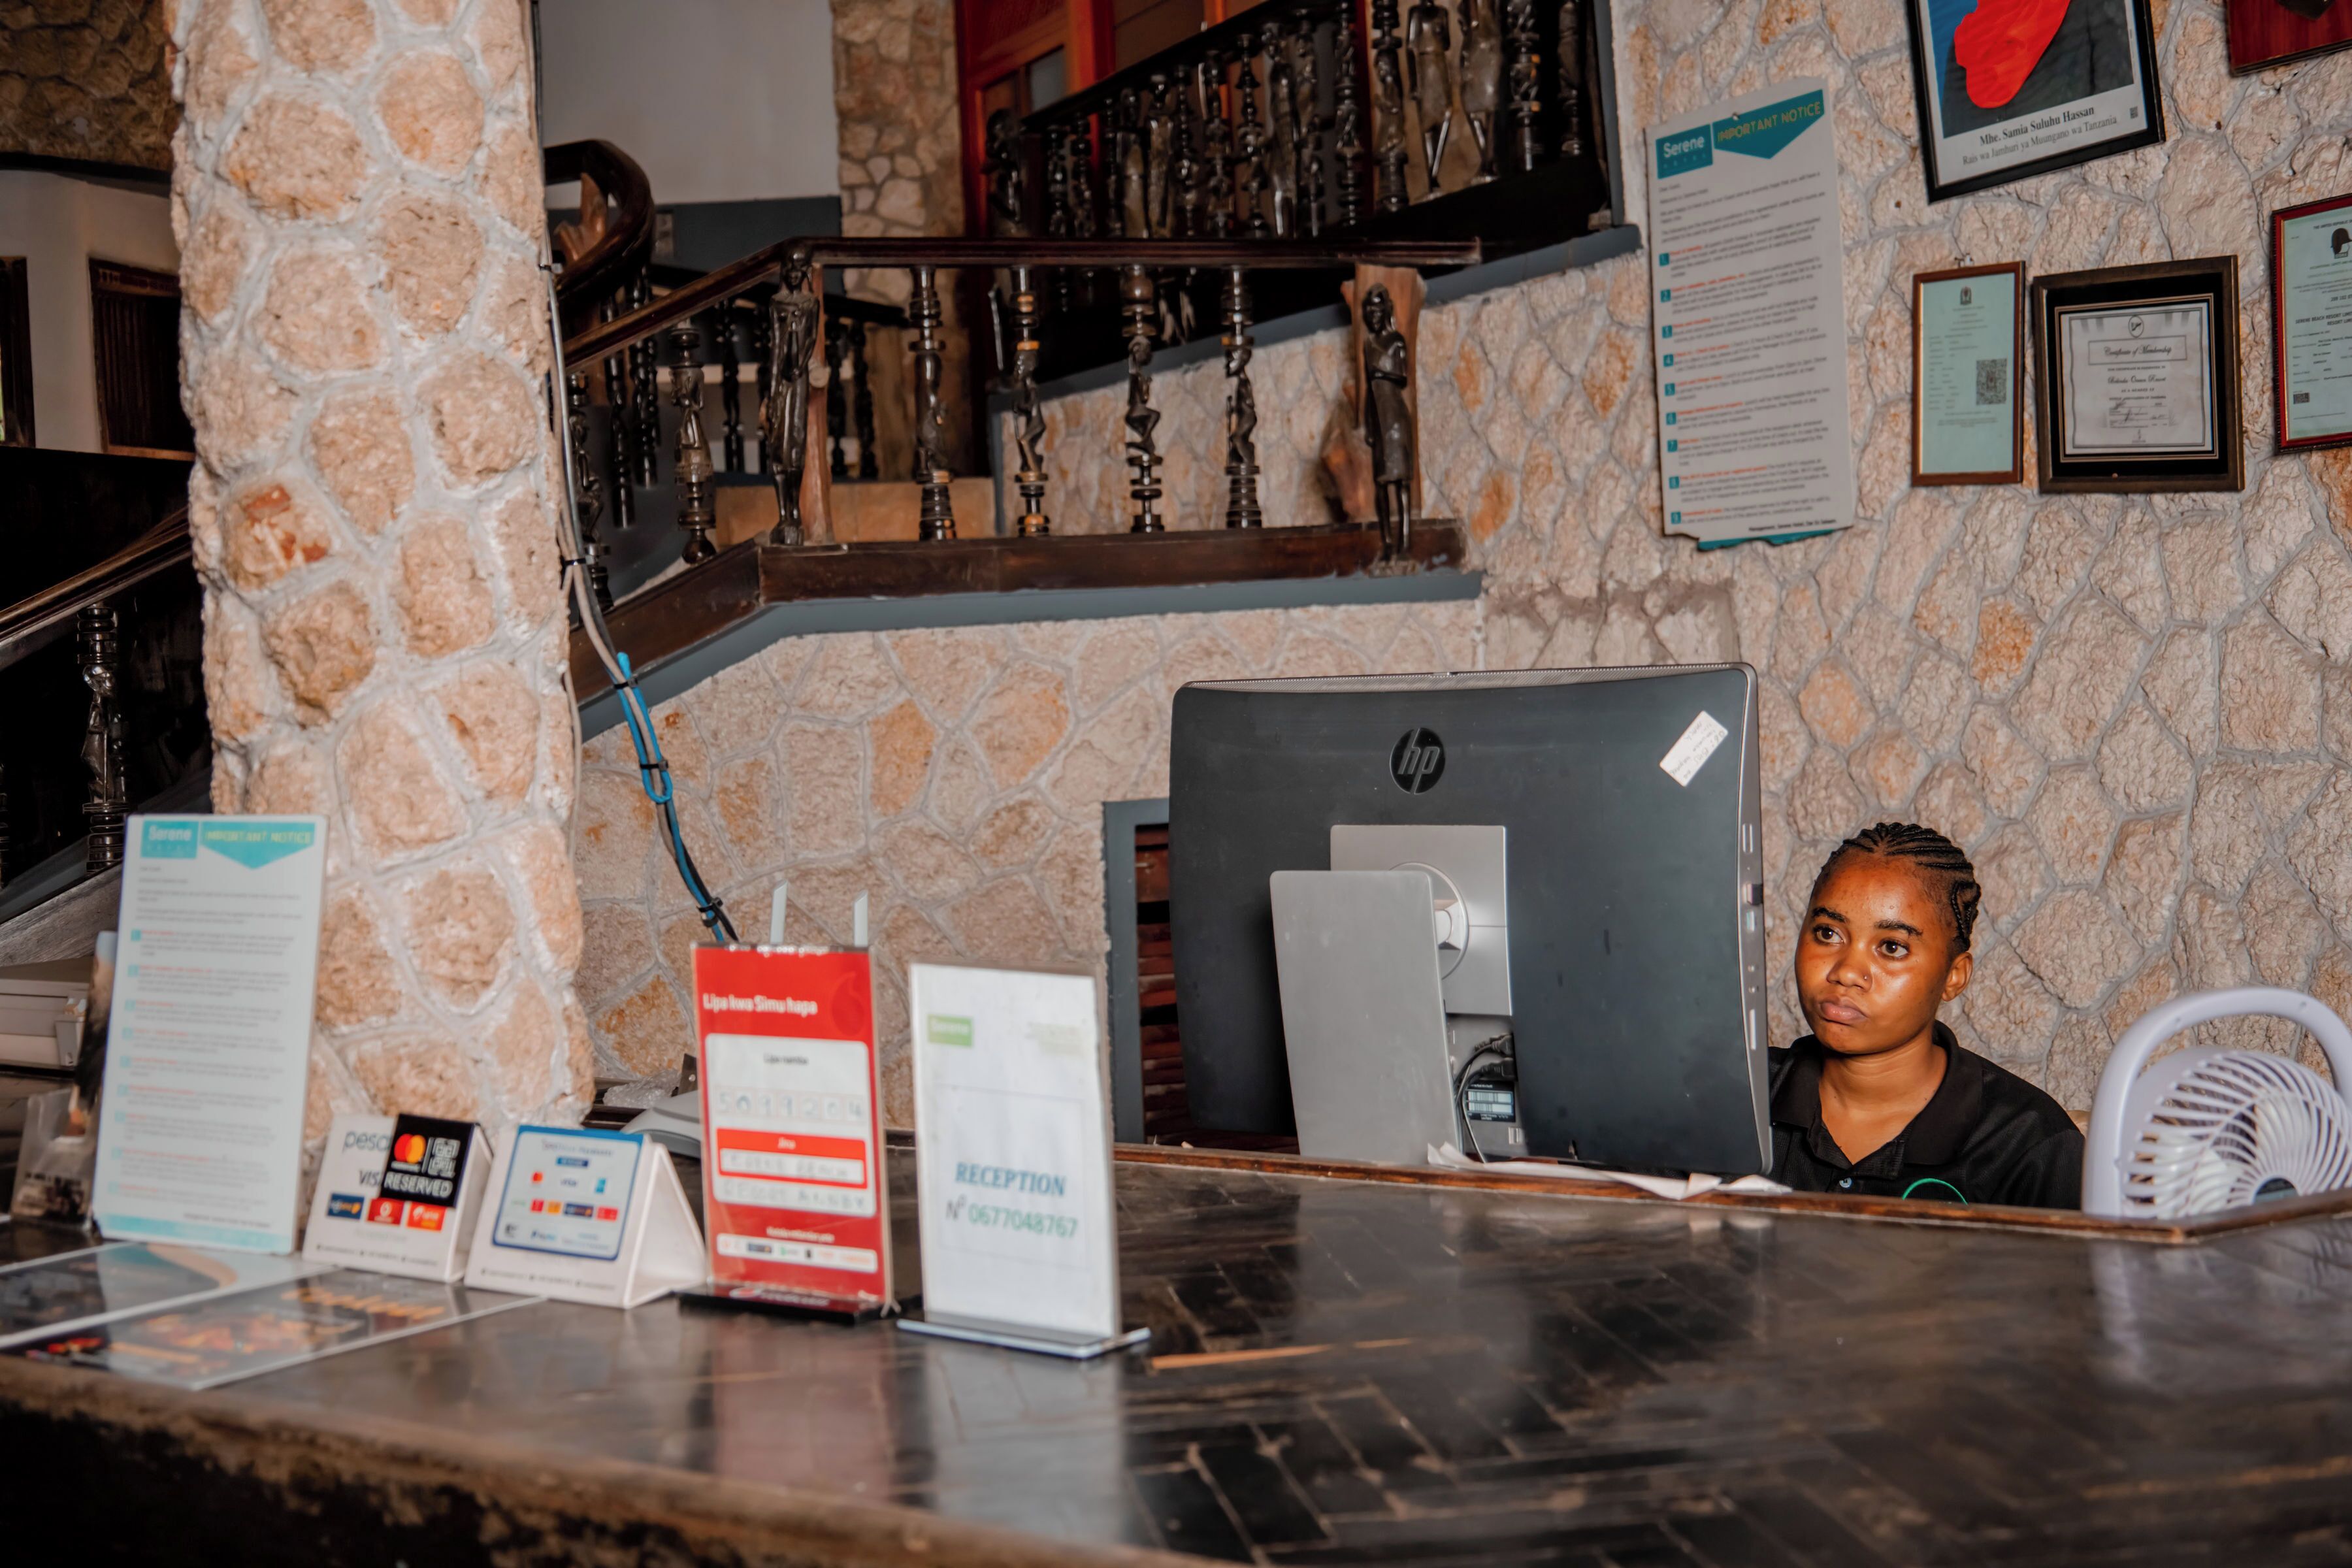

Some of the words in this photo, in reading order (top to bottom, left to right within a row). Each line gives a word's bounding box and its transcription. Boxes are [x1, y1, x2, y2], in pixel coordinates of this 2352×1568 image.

[1718, 114, 1778, 142] IMPORTANT
[1781, 102, 1821, 124] NOTICE
[1980, 135, 2001, 146] Mhe.
[2002, 124, 2028, 140] Samia
[2030, 115, 2060, 131] Suluhu
[2063, 106, 2095, 123] Hassan
[1663, 136, 1705, 158] Serene
[1963, 155, 1978, 165] Rais
[1979, 151, 1990, 160] wa
[1991, 141, 2019, 158] Jamhuri
[2021, 141, 2030, 152] ya
[2031, 130, 2070, 147] Muungano
[2071, 126, 2083, 135] wa
[2083, 115, 2117, 131] Tanzania
[1397, 727, 1440, 794] hp
[148, 825, 191, 841] Serene
[206, 830, 267, 842] IMPORTANT
[270, 831, 312, 843] NOTICE
[703, 992, 728, 1013] Lipa
[728, 994, 753, 1012] kwa
[753, 995, 786, 1013] Simu
[786, 996, 818, 1018] hapa
[359, 1169, 382, 1188] VIS
[384, 1171, 453, 1198] RESERVED
[955, 1162, 1066, 1196] RECEPTION
[968, 1202, 1079, 1237] 0677048767
